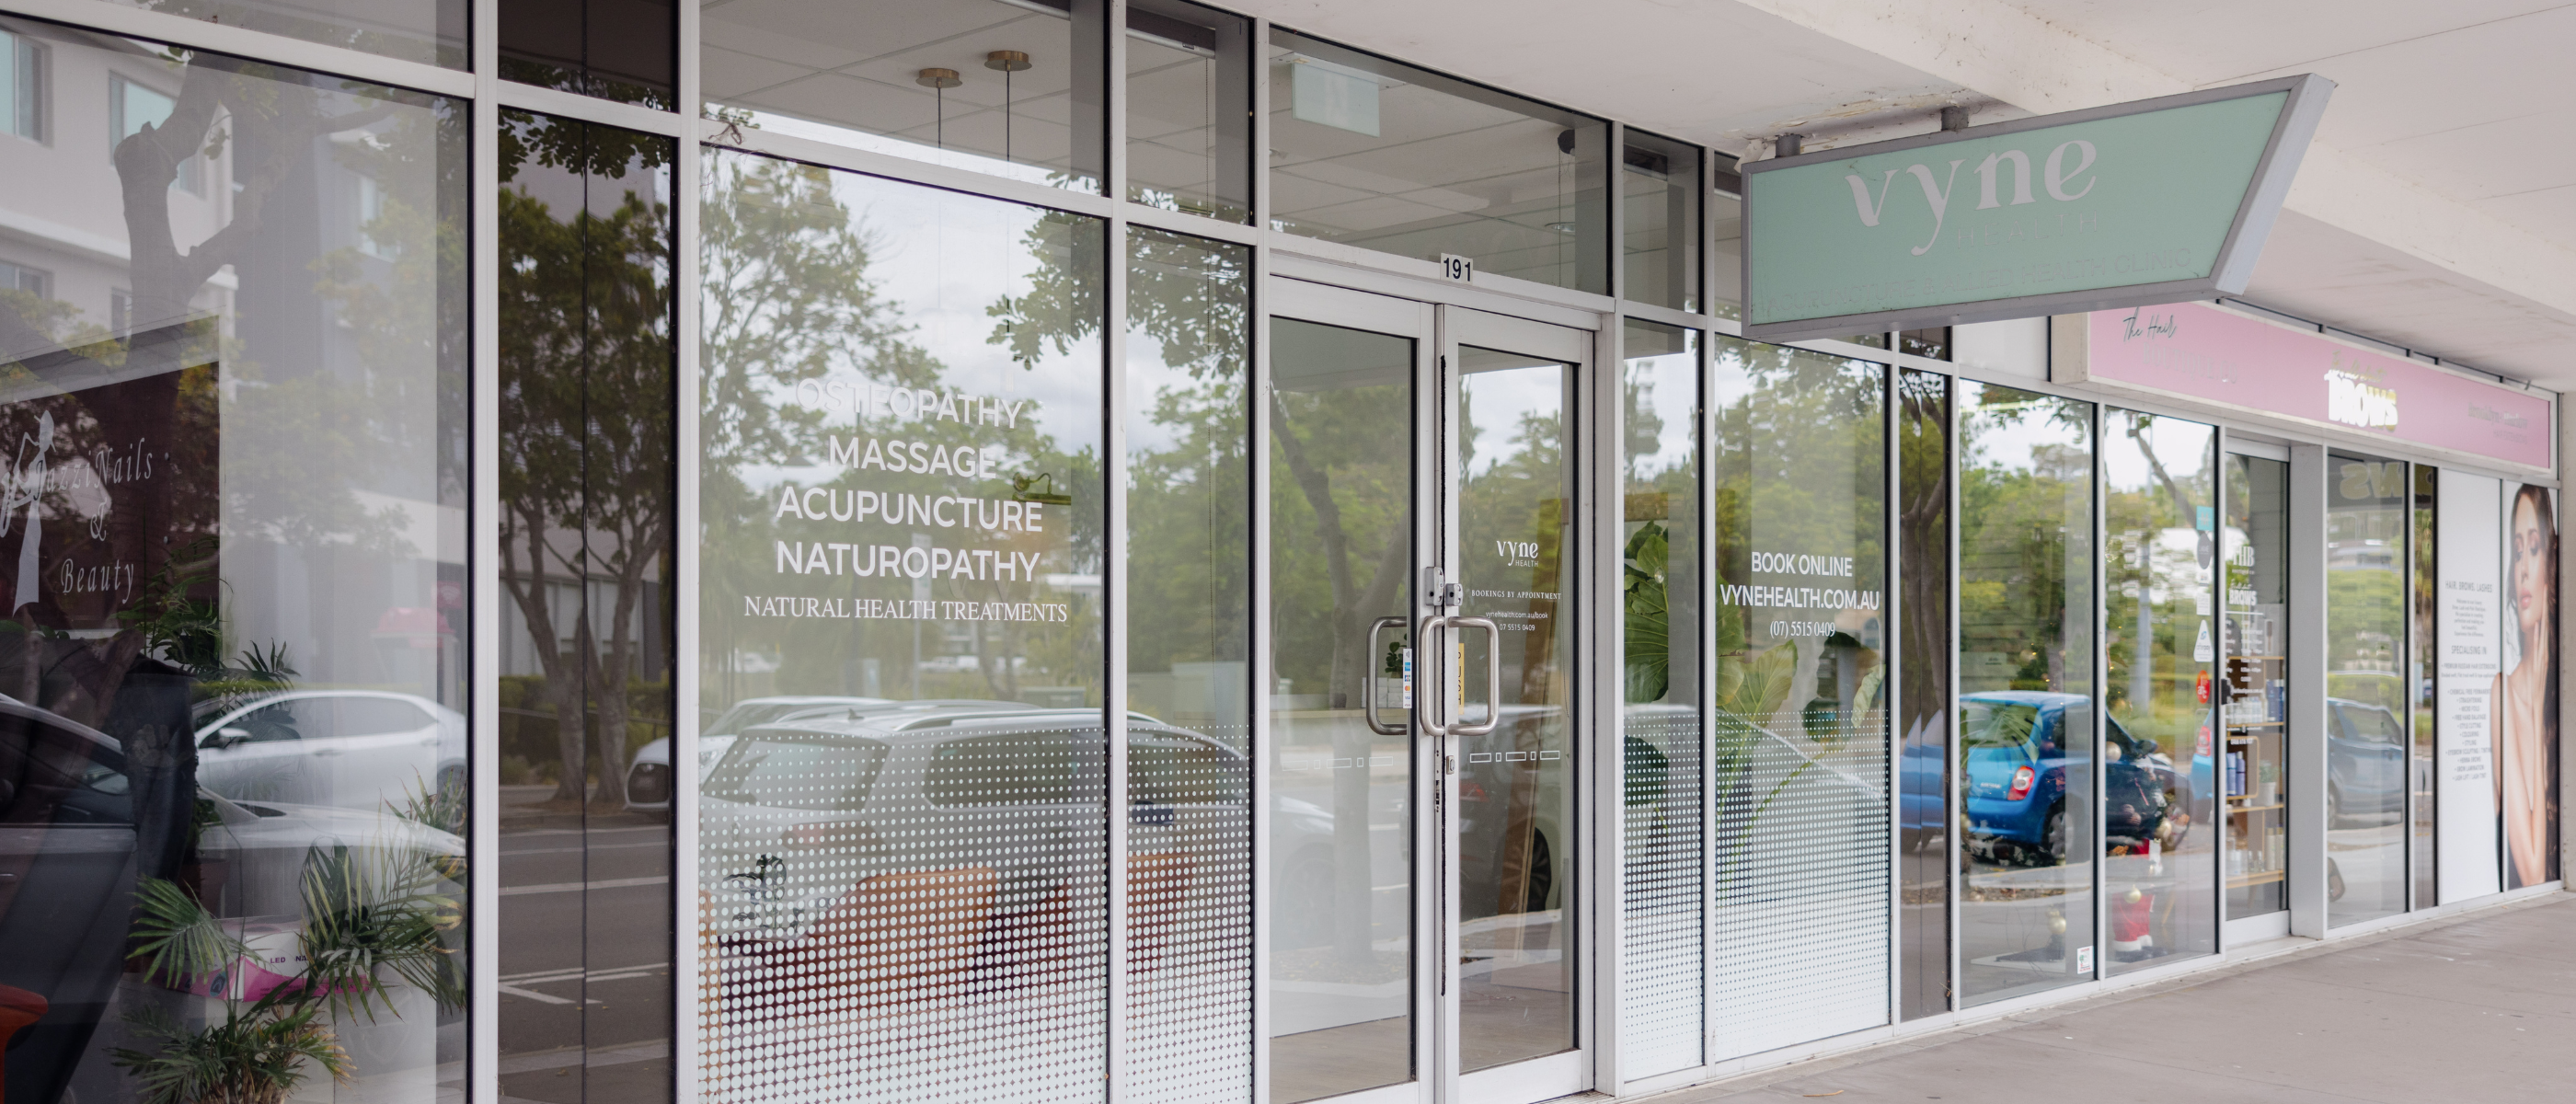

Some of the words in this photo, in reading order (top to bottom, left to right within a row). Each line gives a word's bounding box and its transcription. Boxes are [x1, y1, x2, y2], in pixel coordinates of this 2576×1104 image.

[1844, 140, 2098, 257] vyne
[1957, 210, 2098, 249] HEALTH
[1443, 258, 1470, 282] 191
[1766, 280, 1916, 315] ACUPUNCTURE
[1923, 278, 1934, 295] &
[1941, 269, 2014, 293] ALLIED
[2021, 258, 2106, 283] HEALTH
[2115, 247, 2191, 274] CLINIC
[2122, 306, 2144, 342] The
[2147, 314, 2177, 340] Hair
[795, 377, 1023, 430] OSTEOPATHY
[830, 434, 996, 479] MASSAGE
[776, 486, 1043, 533] ACUPUNCTURE
[776, 540, 1041, 582] NATUROPATHY
[1496, 540, 1538, 566] vyne
[1752, 551, 1796, 574] BOOK
[1799, 555, 1853, 577] ONLINE
[61, 558, 134, 604] Beauty
[1472, 590, 1505, 598] BOOKINGS
[1517, 591, 1561, 600] APPOINTMENT
[1719, 584, 1880, 611] VYNEHEALTH.COM.AU
[744, 595, 850, 617] NATURAL
[855, 598, 937, 620] HEALTH
[941, 601, 1067, 622] TREATMENTS
[1770, 621, 1788, 639] (07)
[1790, 621, 1811, 637] 5515
[1814, 622, 1835, 638] 0409
